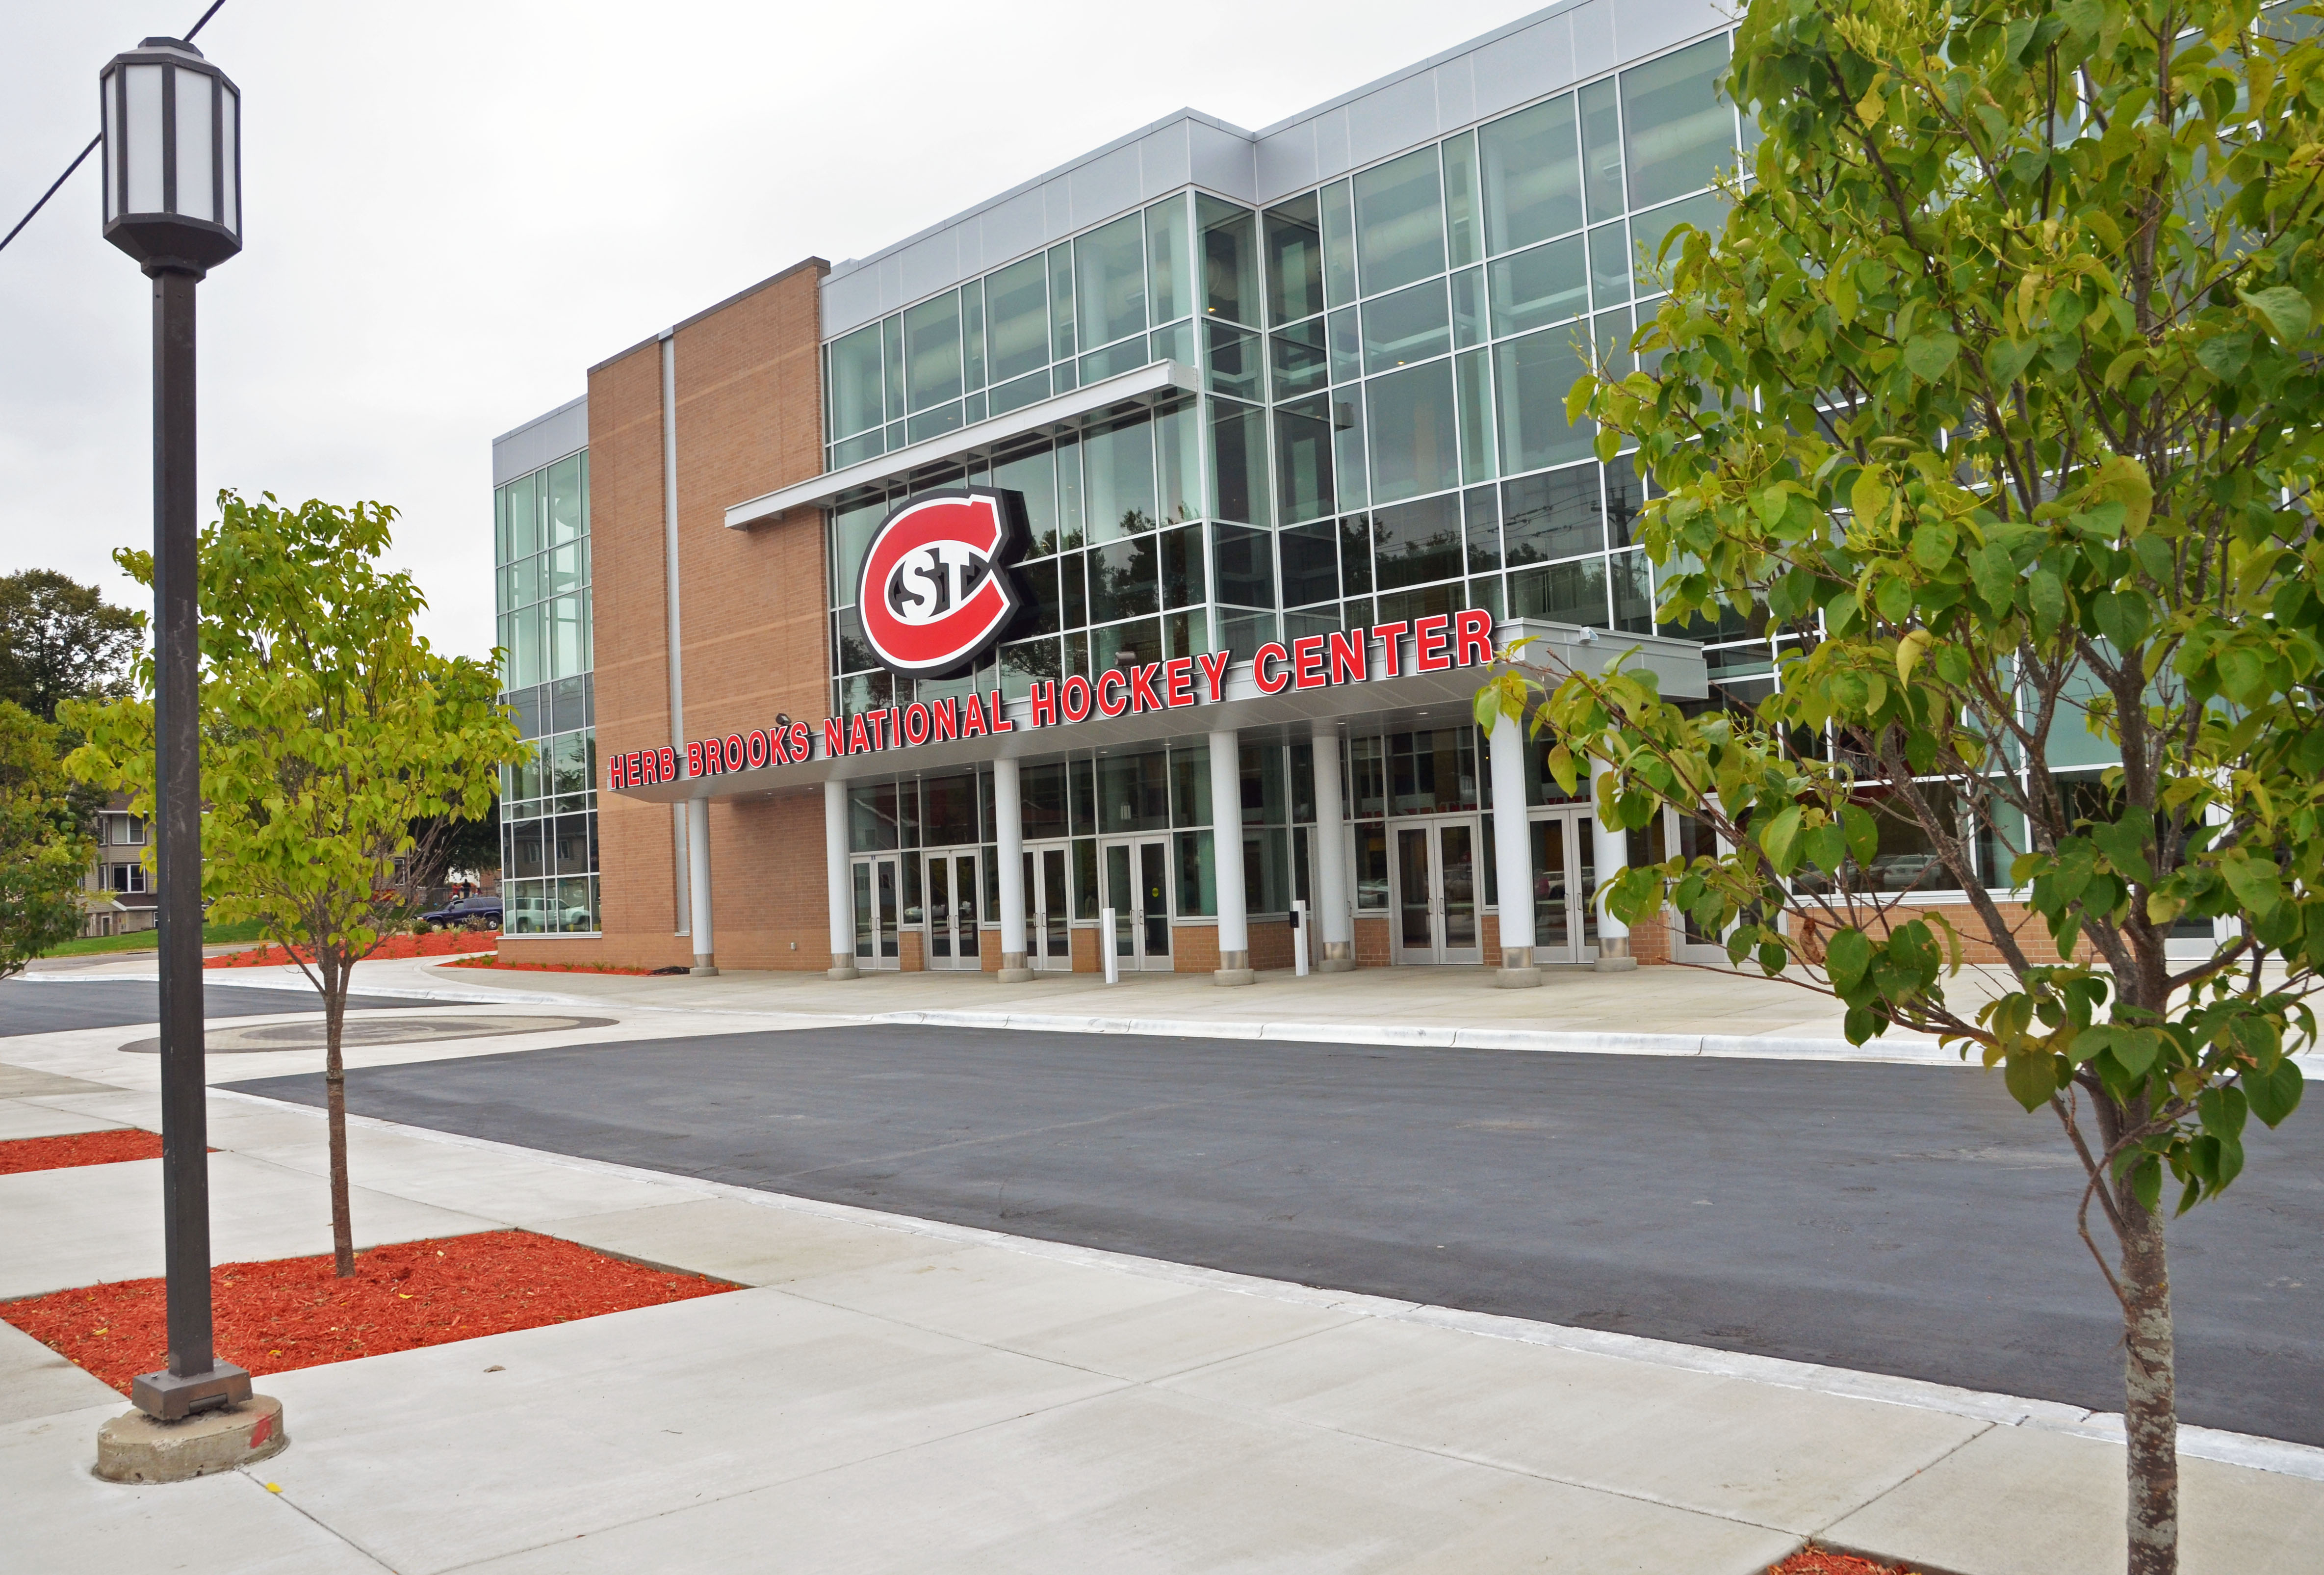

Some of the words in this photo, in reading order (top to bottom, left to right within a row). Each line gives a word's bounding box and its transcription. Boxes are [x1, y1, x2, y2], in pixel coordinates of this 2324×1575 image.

[609, 746, 676, 789] HERB
[686, 721, 810, 778] BROOKS
[823, 689, 1014, 758] NATIONAL
[1030, 650, 1230, 728] HOCKEY
[1252, 608, 1494, 695] CENTER
